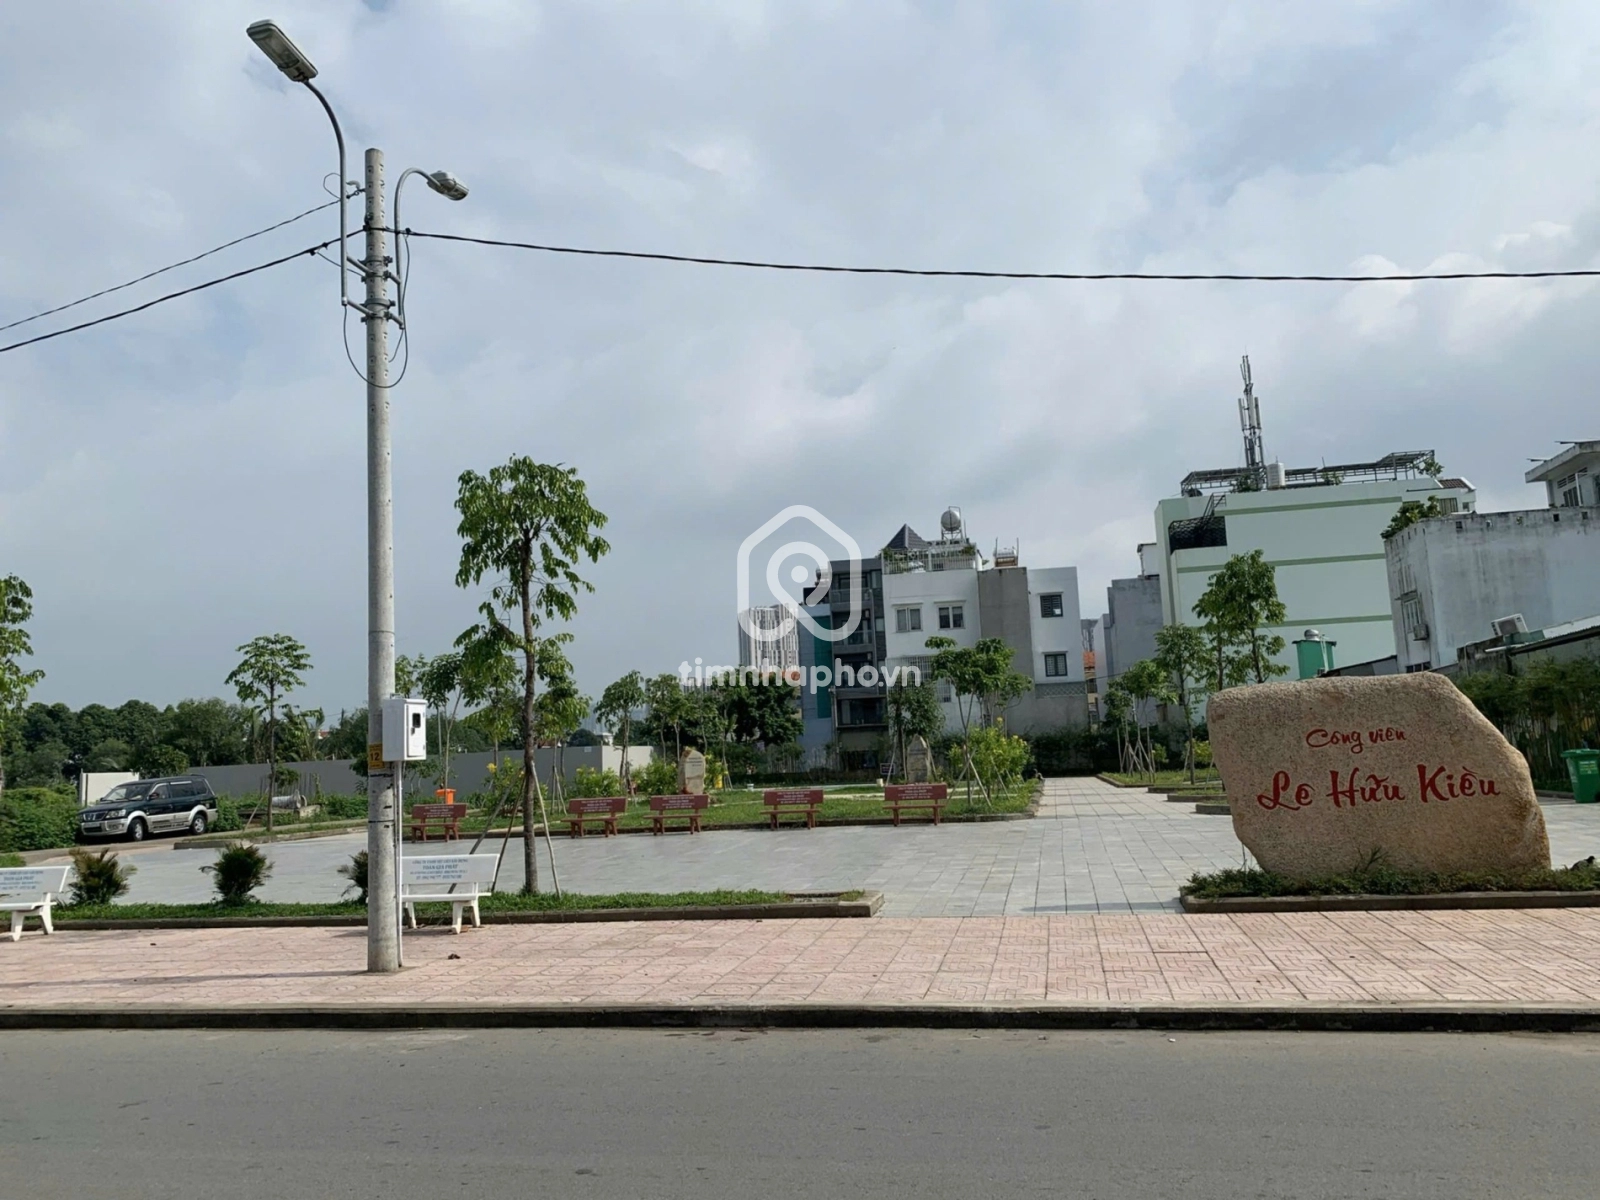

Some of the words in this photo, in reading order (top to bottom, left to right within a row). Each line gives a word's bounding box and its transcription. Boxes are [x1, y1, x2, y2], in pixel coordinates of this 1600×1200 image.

[1306, 728, 1364, 754] Công
[1369, 727, 1407, 744] viên
[370, 751, 381, 762] 12
[1257, 770, 1316, 811] Lê
[1326, 767, 1406, 808] Hữu
[1417, 764, 1501, 803] Kiều
